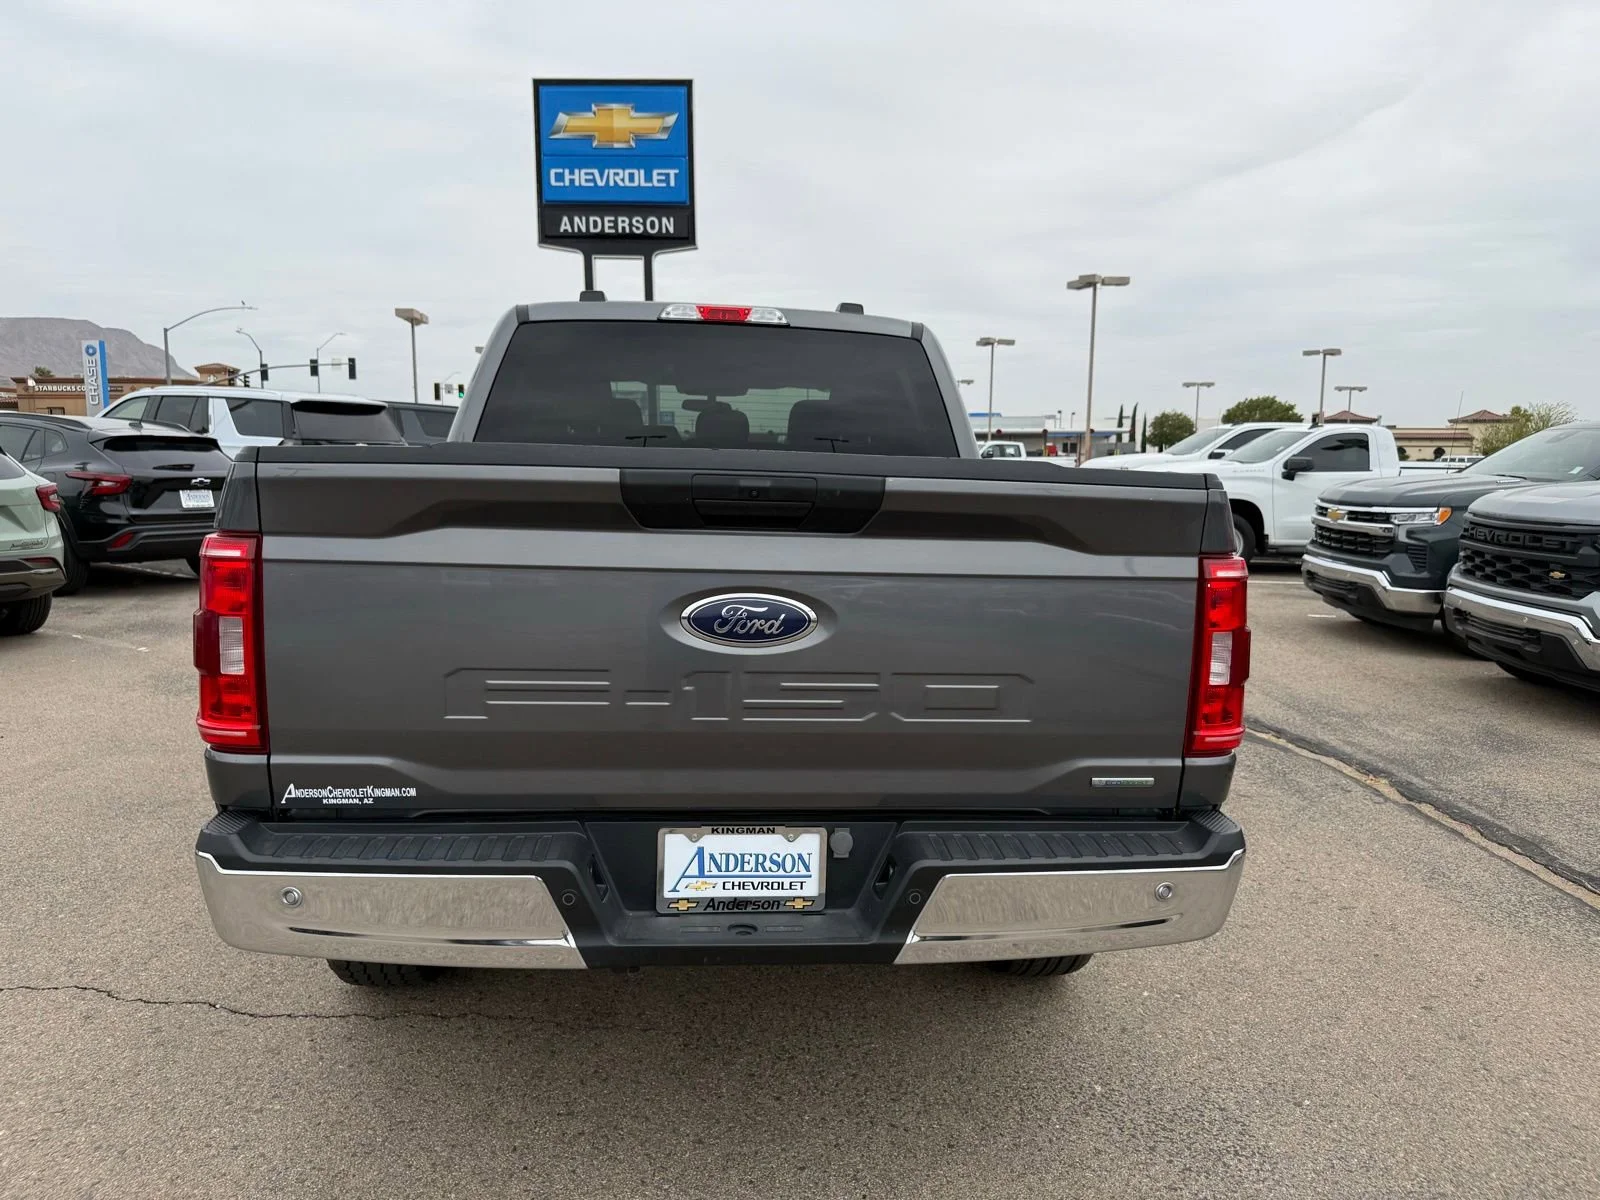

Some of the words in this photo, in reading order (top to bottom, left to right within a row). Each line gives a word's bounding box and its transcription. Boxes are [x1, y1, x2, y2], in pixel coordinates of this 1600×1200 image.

[550, 168, 679, 187] CHEVROLET
[560, 215, 674, 234] ANDERSON
[86, 358, 99, 405] CHASE
[713, 604, 786, 634] Ford
[444, 668, 1034, 723] F-150
[722, 881, 806, 891] CHEVROLET
[703, 897, 781, 911] Anderson
